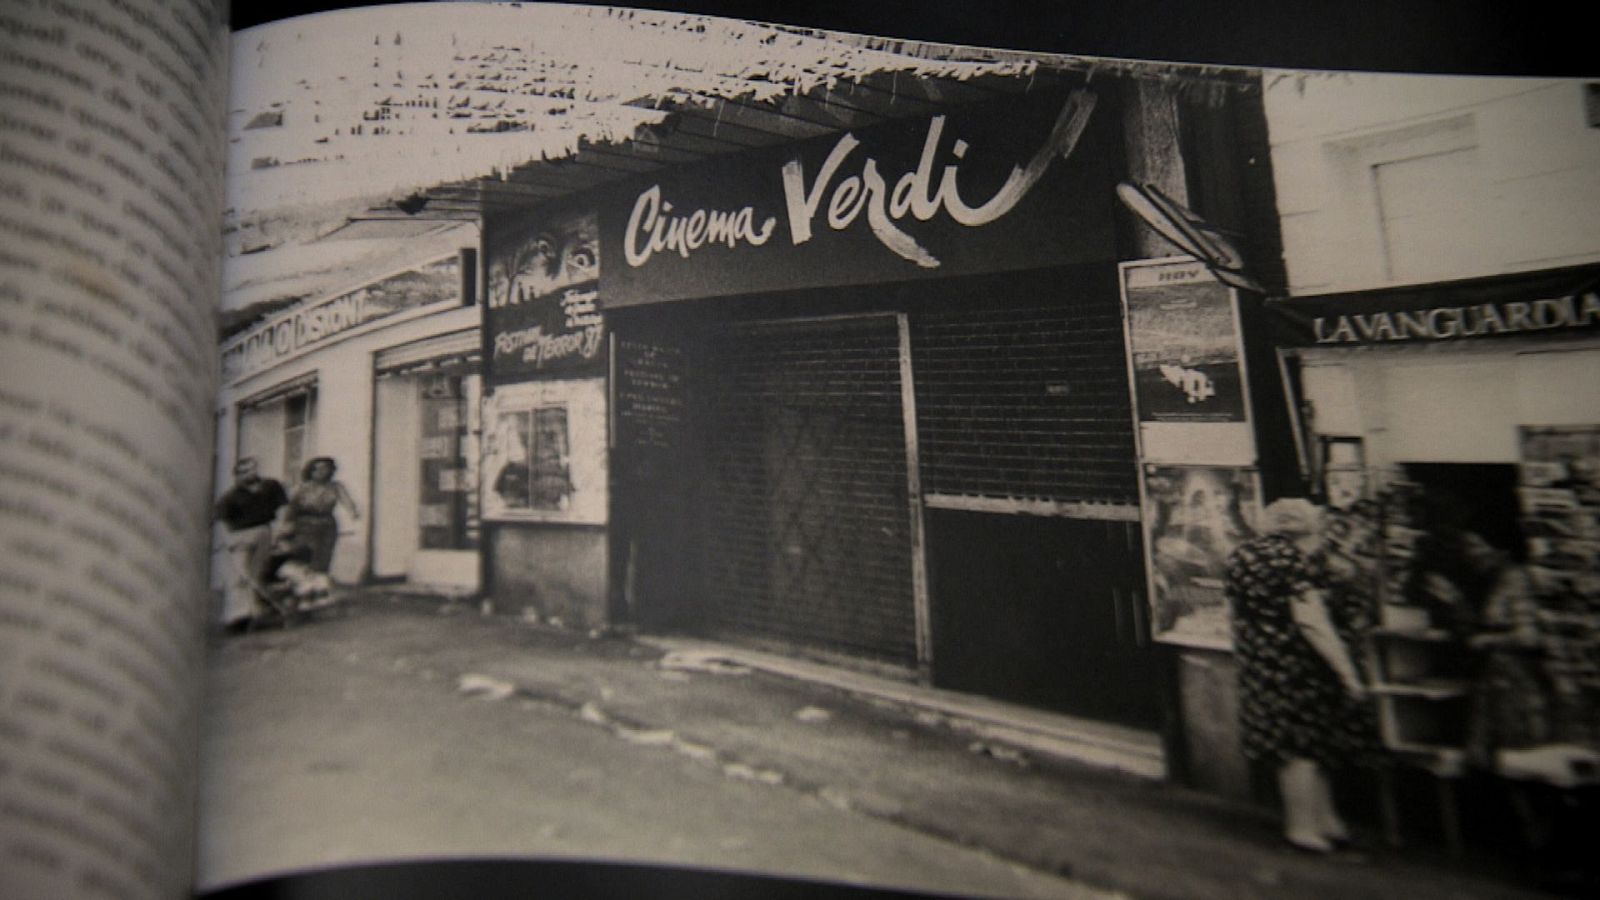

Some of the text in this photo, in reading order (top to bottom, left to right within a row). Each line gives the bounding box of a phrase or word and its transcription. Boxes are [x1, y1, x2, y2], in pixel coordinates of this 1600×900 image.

[624, 88, 1098, 268] Cinema Verdi
[1158, 270, 1199, 282] HOY
